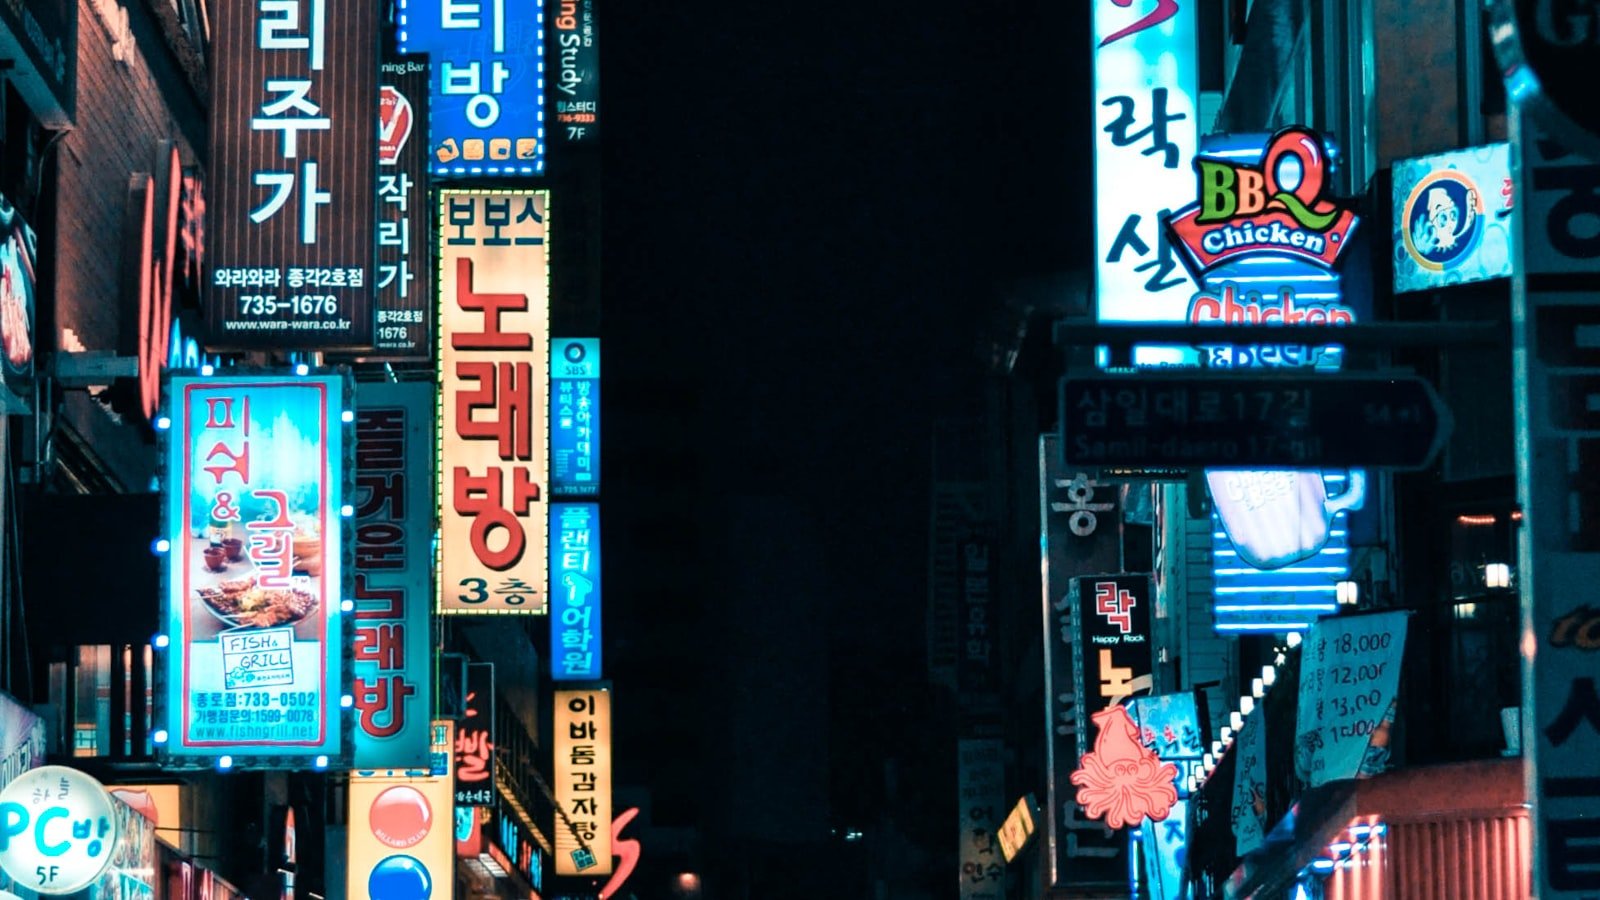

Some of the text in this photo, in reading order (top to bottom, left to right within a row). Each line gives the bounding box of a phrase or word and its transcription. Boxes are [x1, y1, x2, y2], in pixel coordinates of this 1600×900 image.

[407, 61, 425, 73] Bar
[557, 33, 582, 96] Study
[567, 126, 586, 140] 7F
[1196, 130, 1338, 230] BBQ
[447, 197, 544, 246] 보보스
[1202, 221, 1325, 255] Chicken
[215, 268, 364, 288] 와라와라 종각2호점
[240, 295, 337, 315] 735-1676
[1192, 286, 1354, 325] Chicken
[225, 318, 352, 330] www.wara-wara.co.kr
[376, 326, 407, 340] 1676
[566, 366, 585, 375] SBS
[451, 257, 540, 572] 노래방
[576, 381, 591, 471] 방송아카데미
[211, 491, 240, 522] &
[246, 490, 295, 587] 그릴
[560, 507, 591, 572] 플랜티
[457, 576, 537, 606] 3층
[1095, 581, 1137, 634] 락
[230, 635, 271, 651] FISH
[561, 606, 593, 675] 어학원
[1092, 634, 1146, 645] Happy Rock
[1334, 632, 1391, 656] 18,000
[240, 653, 289, 669] GRILL
[1099, 648, 1133, 700] 노
[197, 692, 316, 708] 종로점:733-0502
[568, 695, 598, 840] 이바돔감자탕
[0, 802, 111, 858] PC방
[36, 866, 60, 885] 5F
